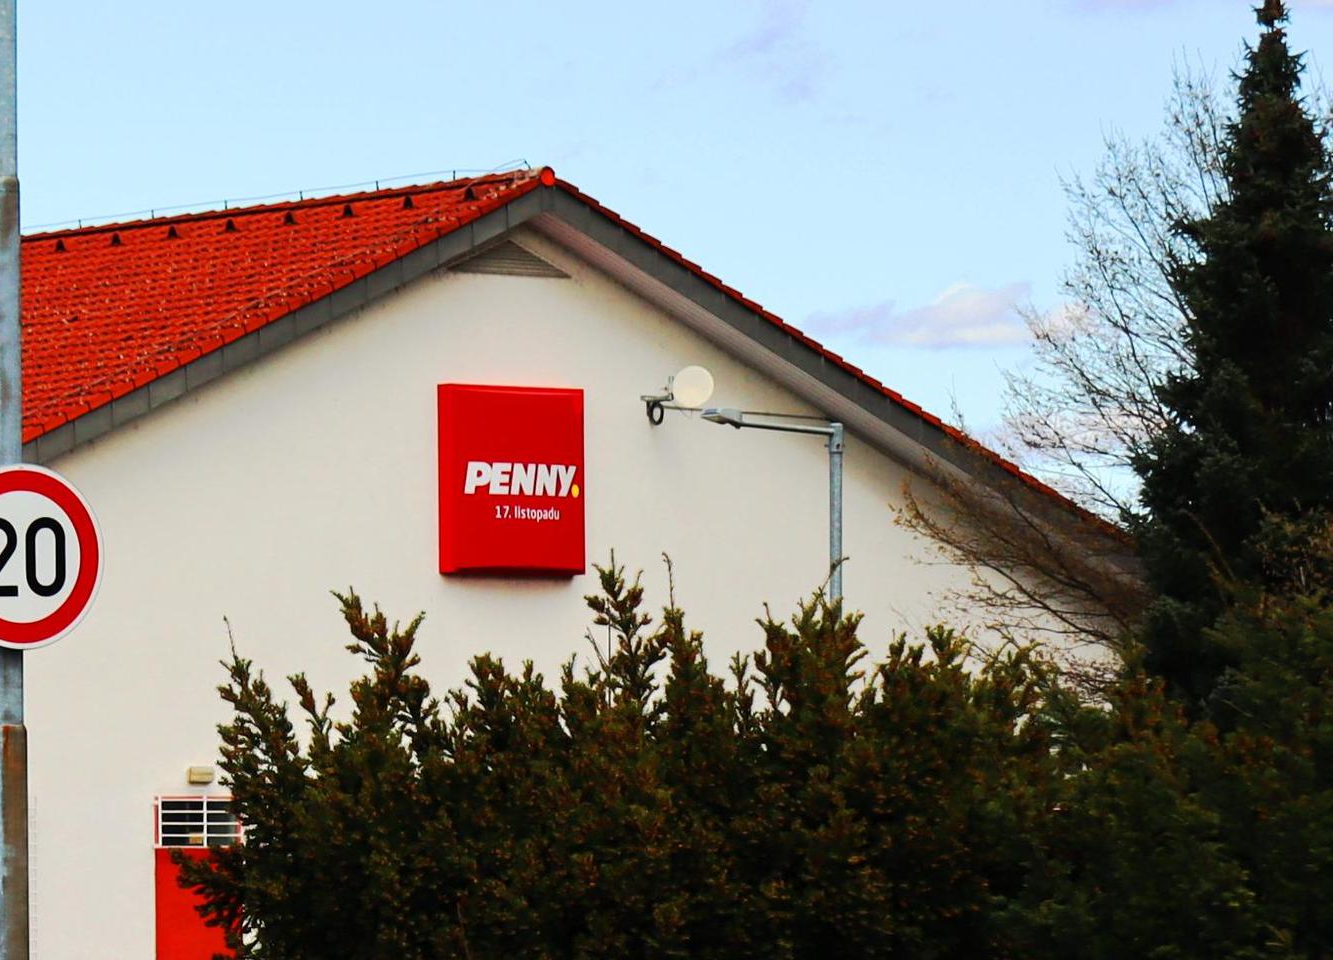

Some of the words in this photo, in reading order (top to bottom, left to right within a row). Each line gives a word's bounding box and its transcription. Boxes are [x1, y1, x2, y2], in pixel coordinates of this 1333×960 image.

[464, 461, 579, 498] PENNY.
[495, 505, 511, 519] 17.
[514, 506, 560, 522] listopadu
